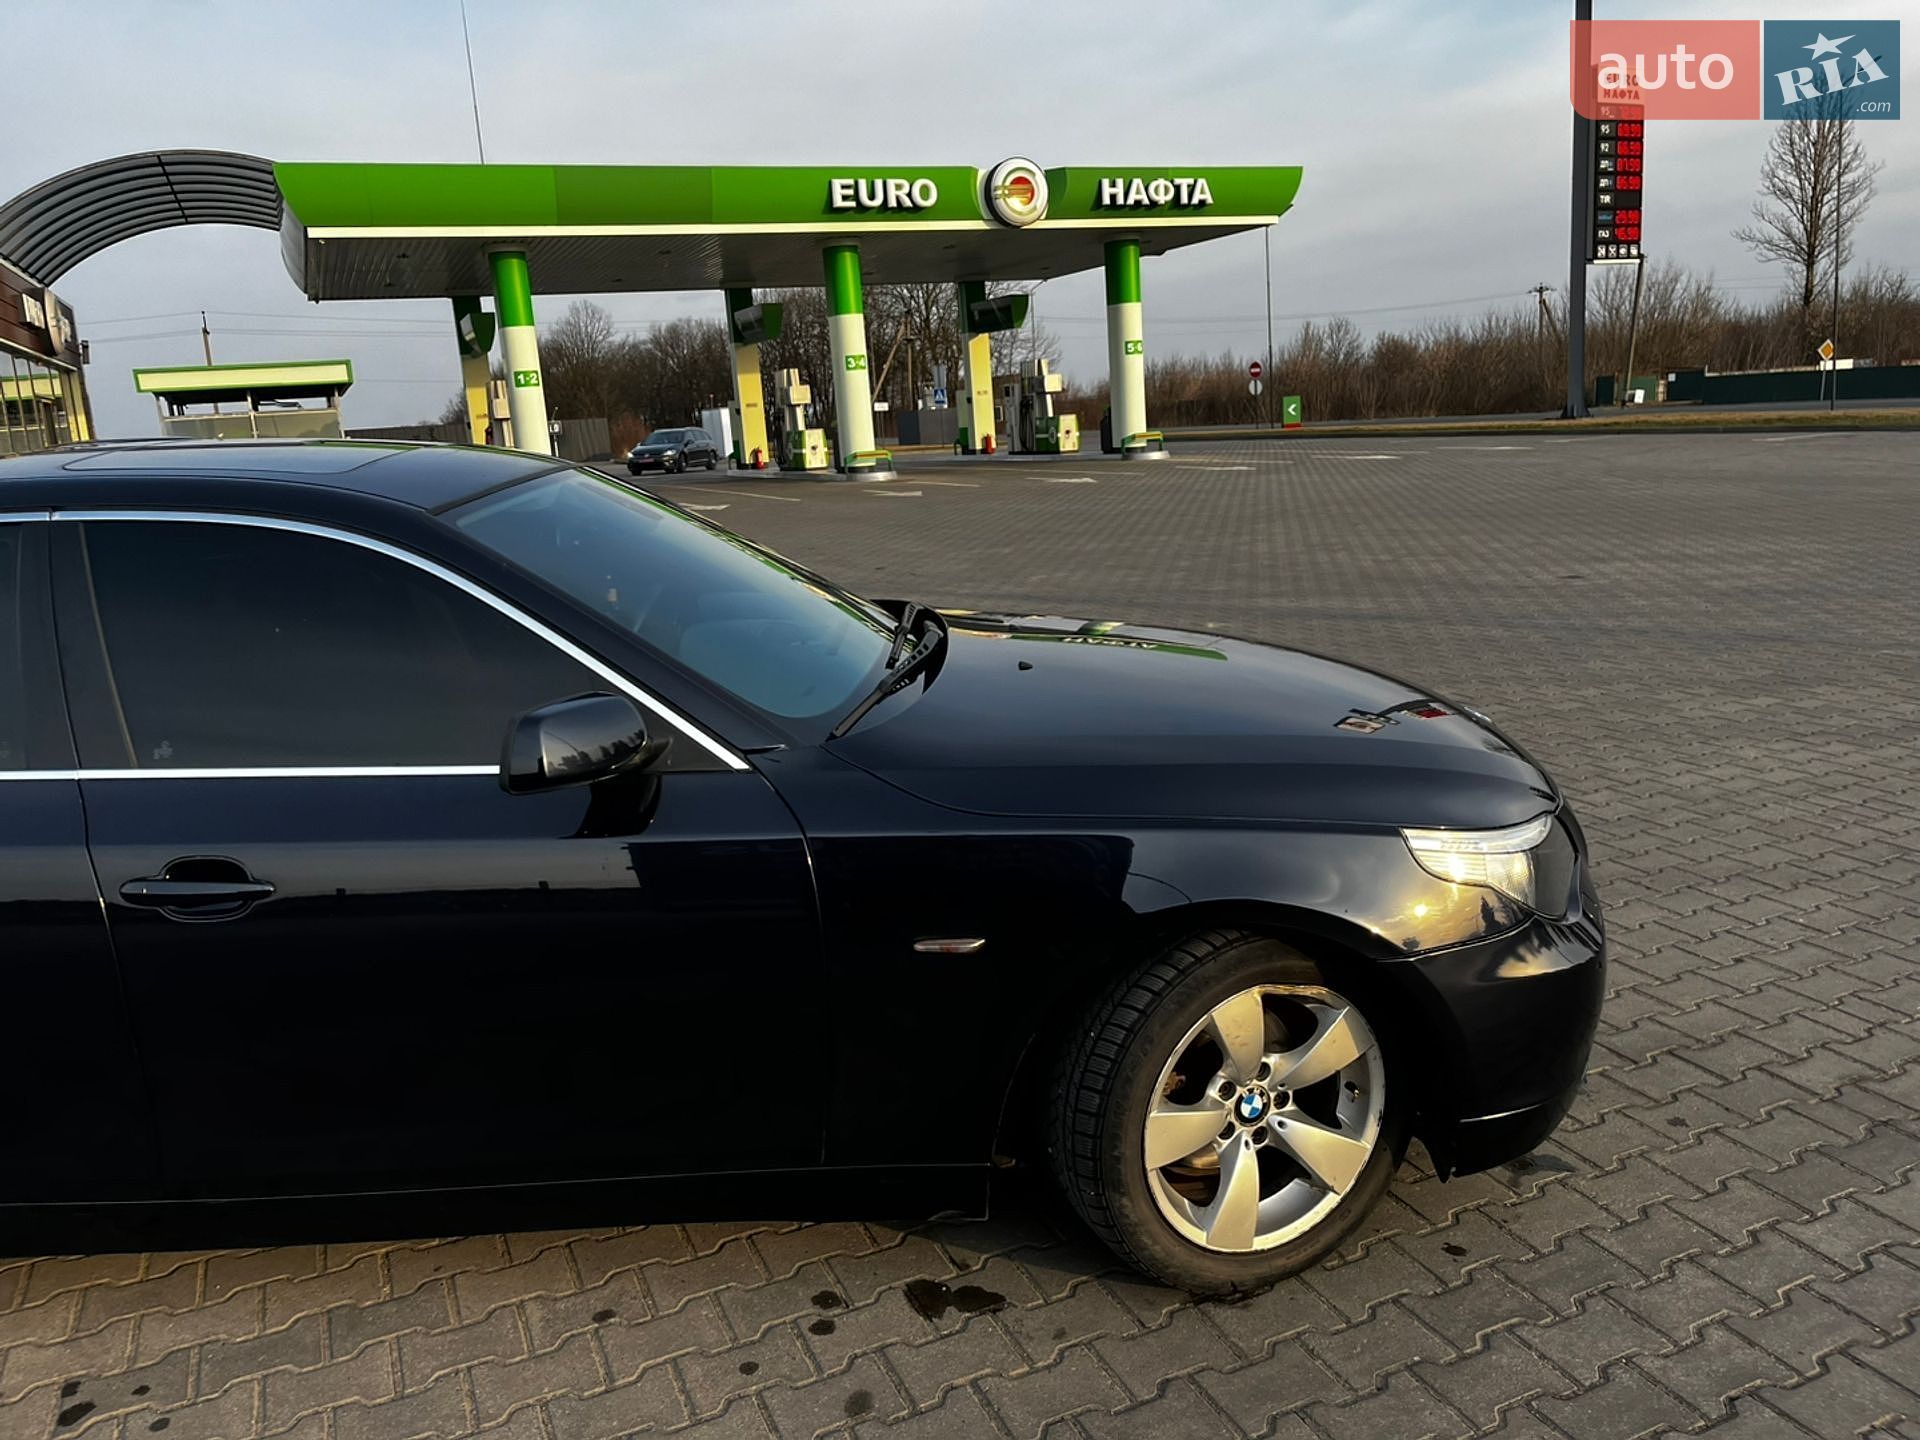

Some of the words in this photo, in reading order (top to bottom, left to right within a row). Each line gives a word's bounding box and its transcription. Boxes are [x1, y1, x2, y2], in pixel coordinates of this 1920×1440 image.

[1600, 124, 1611, 134] 95
[1600, 142, 1610, 152] 92
[831, 177, 939, 209] EURO
[1100, 176, 1214, 206] НАФТА
[517, 372, 538, 385] 1-2
